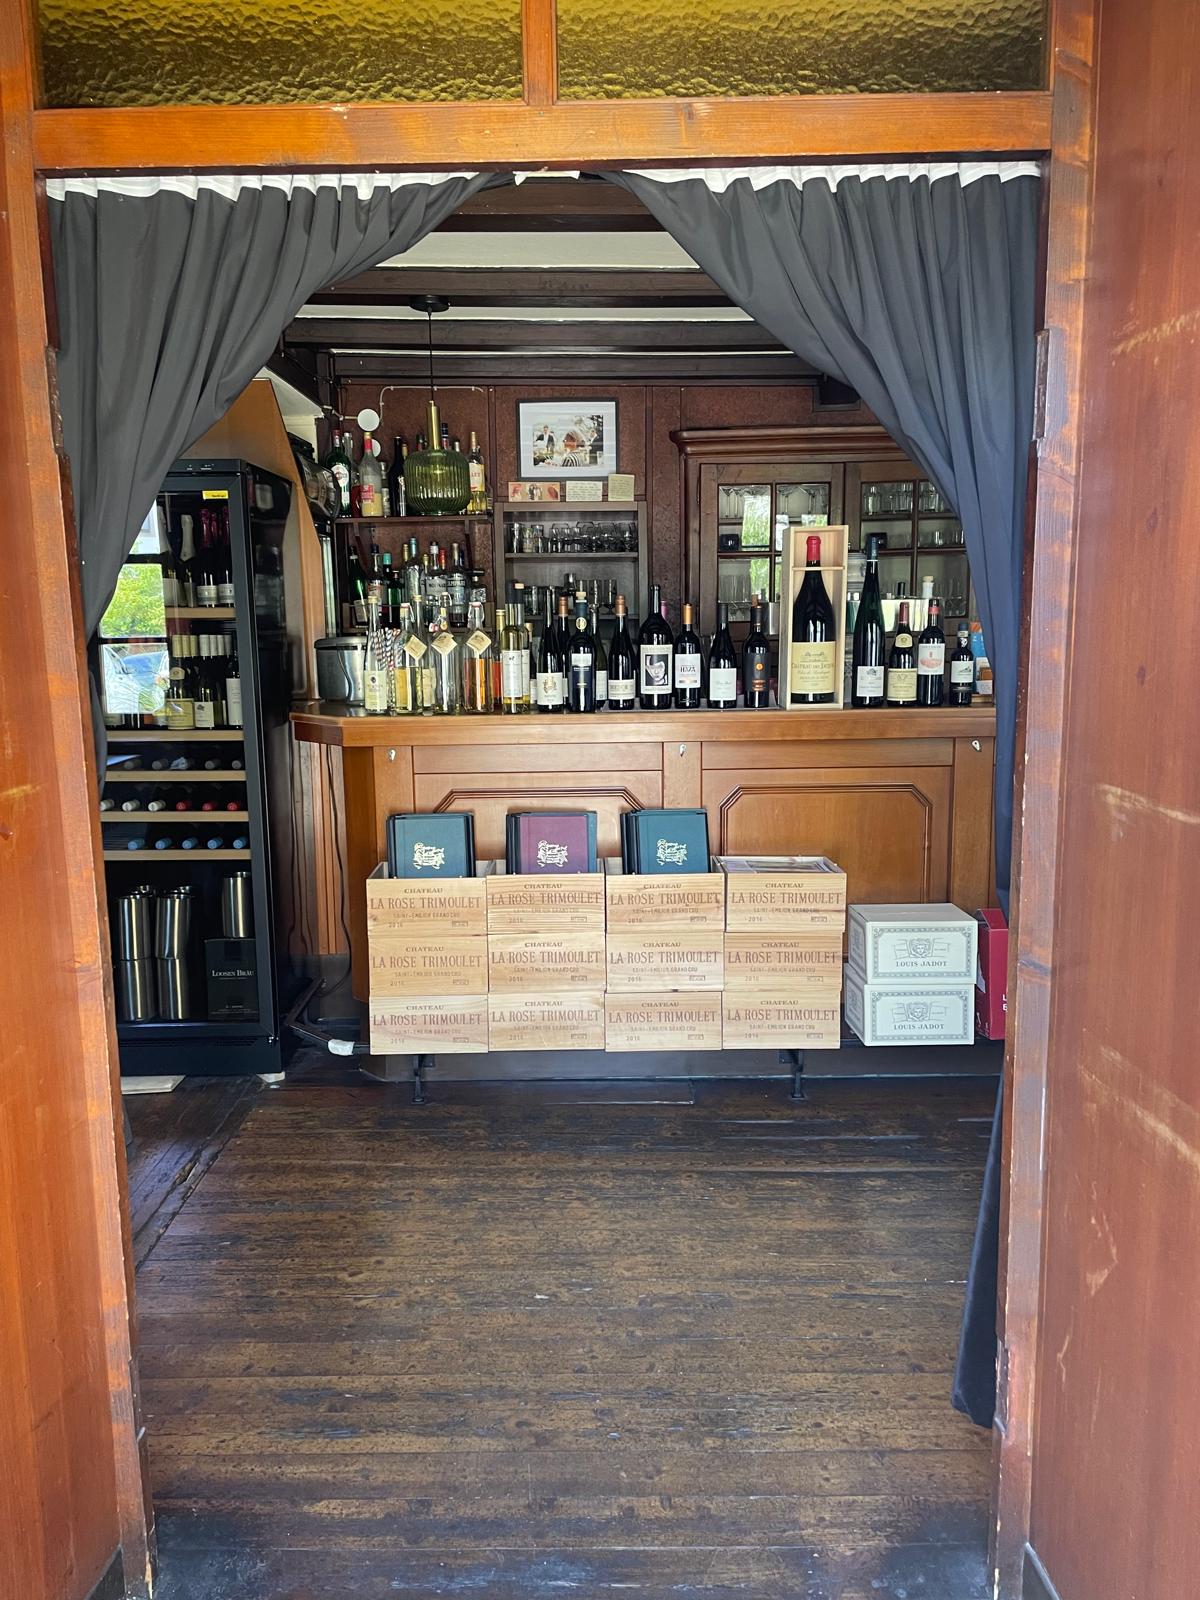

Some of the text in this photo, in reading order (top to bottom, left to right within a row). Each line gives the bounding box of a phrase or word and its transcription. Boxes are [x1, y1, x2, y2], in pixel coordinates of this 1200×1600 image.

[370, 896, 484, 910] LA ROSE TRIMOULET
[491, 891, 602, 905] LA ROSE TRIMOULET
[610, 892, 721, 906] LA ROSE TRIMOULET
[731, 892, 843, 905] LA ROSE TRIMOULET
[372, 955, 484, 969] LA ROSE TRIMOULET
[492, 951, 601, 964] LA ROSE TRIMOULET
[611, 950, 720, 964] LA ROSE TRIMOULET
[727, 952, 839, 964] LA ROSE TRIMOULET
[373, 1013, 482, 1027] LA ROSE TRIMOULET
[492, 1009, 601, 1023] LA ROSE TRIMOULET
[609, 1010, 718, 1024] LA ROSE TRIMOULET
[729, 1009, 838, 1021] LA ROSE TRIMOULET
